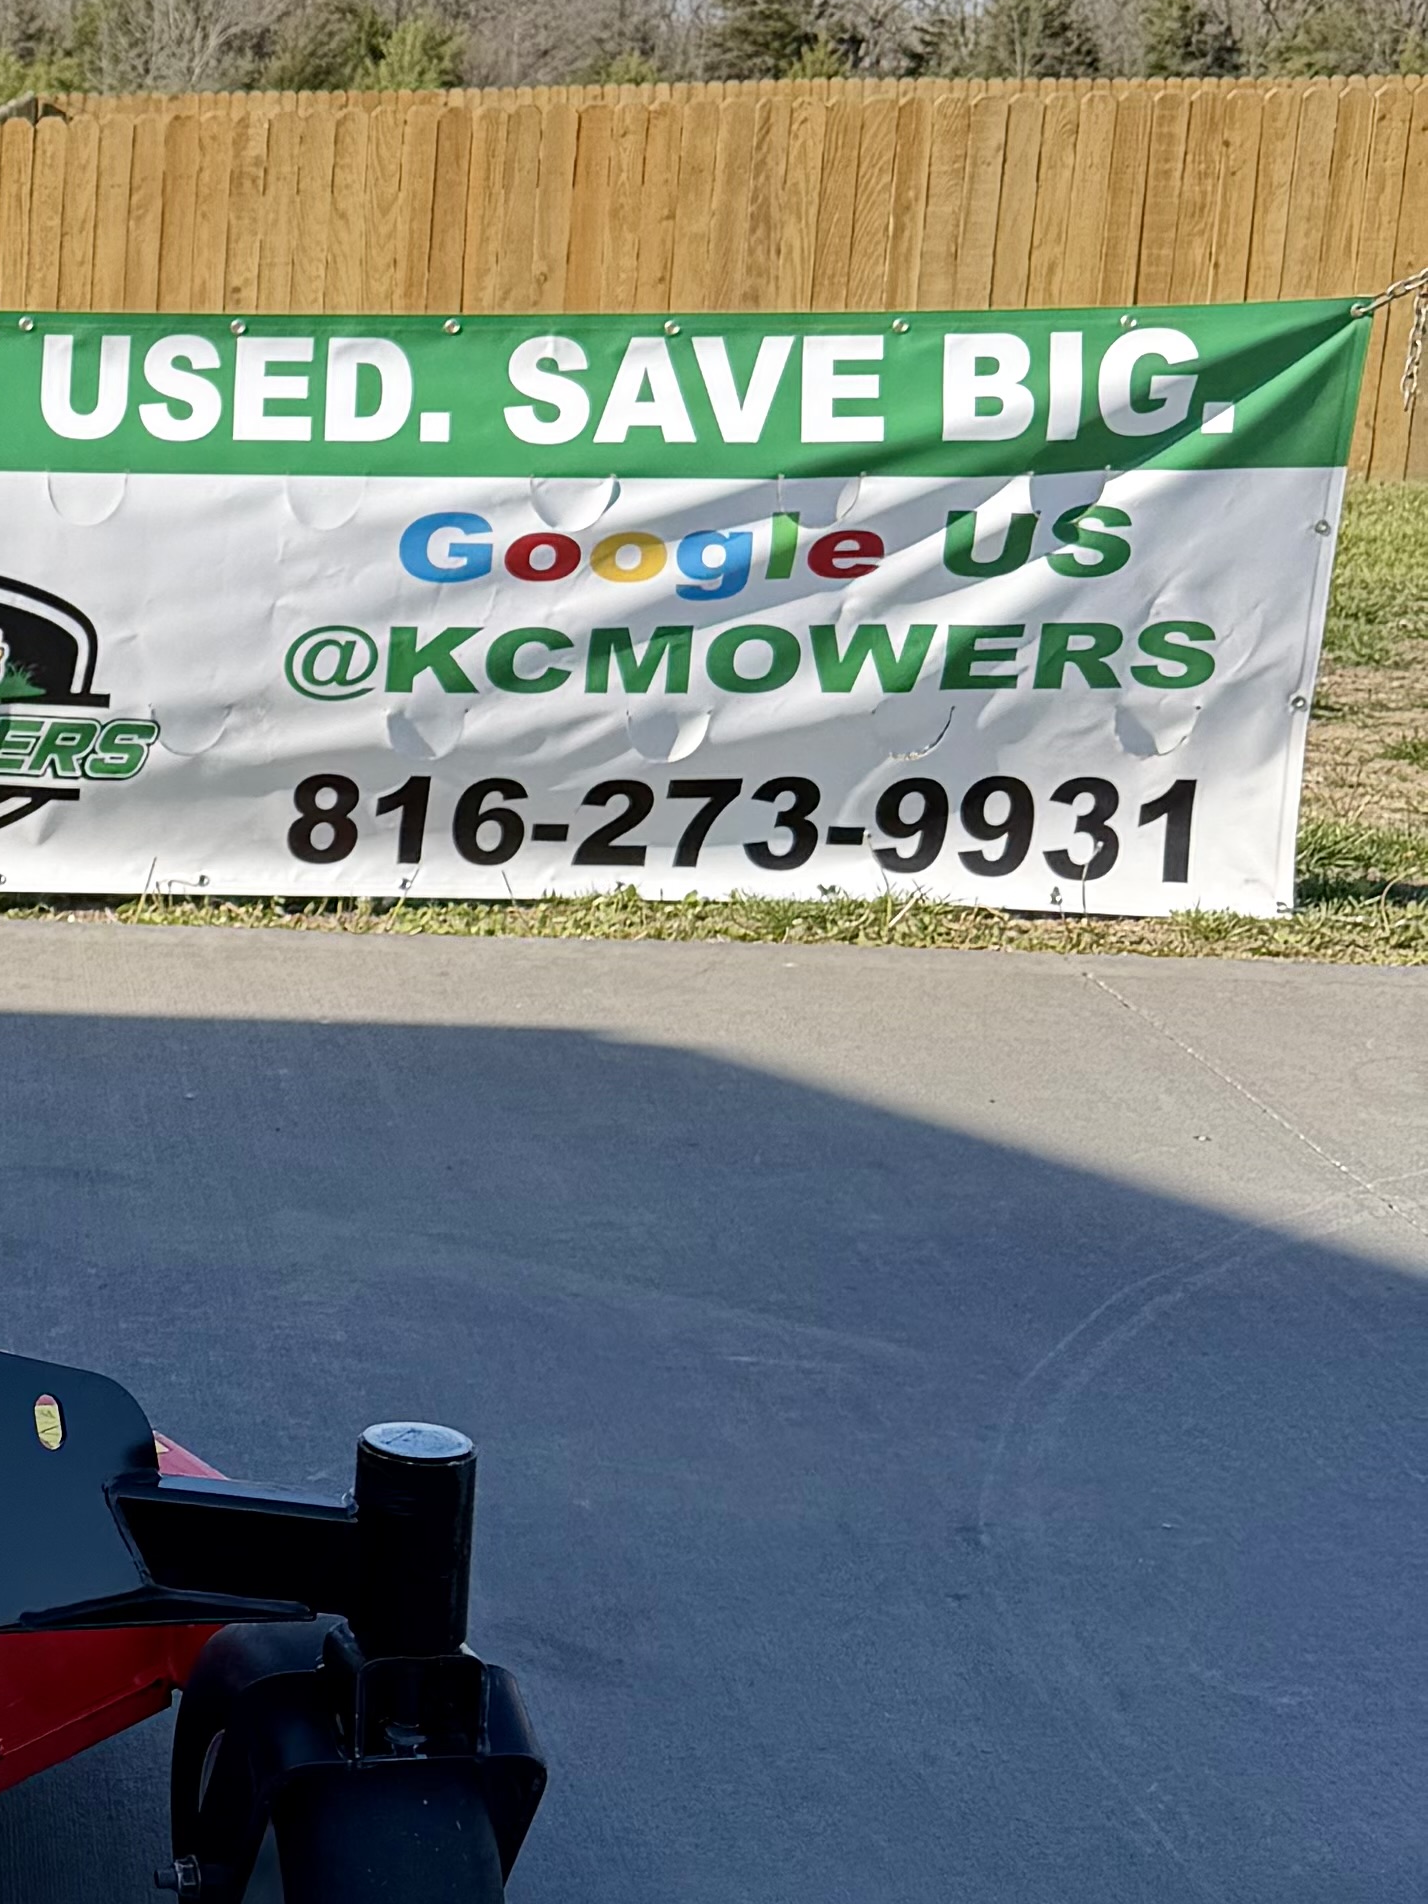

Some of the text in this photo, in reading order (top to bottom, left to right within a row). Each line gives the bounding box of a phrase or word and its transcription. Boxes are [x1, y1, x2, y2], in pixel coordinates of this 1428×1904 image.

[40, 334, 451, 443] USED.
[503, 335, 885, 443] SAVE
[943, 327, 1235, 442] BIG.
[399, 504, 1132, 601] Google US
[285, 620, 1216, 701] @KCMOWERS
[287, 773, 1197, 883] 816-273-9931
